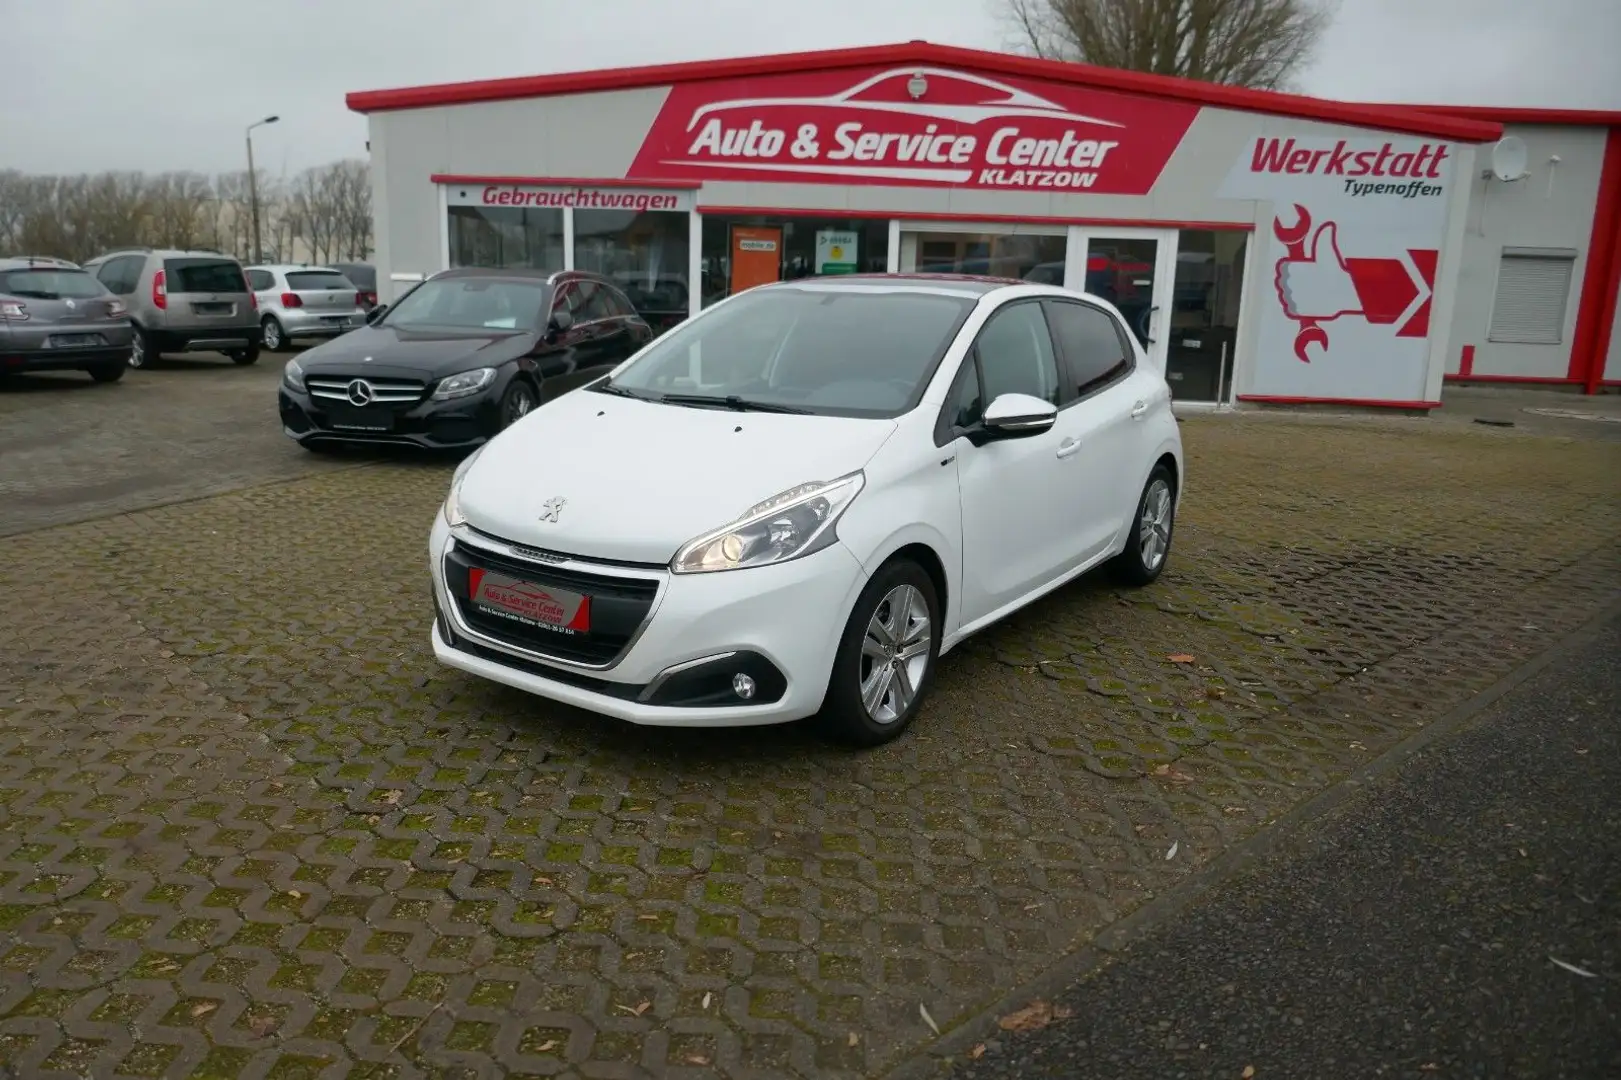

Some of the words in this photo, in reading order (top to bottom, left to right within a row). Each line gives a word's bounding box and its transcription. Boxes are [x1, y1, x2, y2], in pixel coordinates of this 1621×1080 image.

[688, 118, 785, 157] Auto
[790, 123, 820, 159] &
[827, 122, 976, 163] Service
[985, 127, 1119, 168] Center
[1251, 137, 1449, 178] Werkstatt
[978, 169, 1098, 187] KLATZOW
[1344, 179, 1443, 198] Typenoffen
[482, 185, 678, 213] Gebrauchtwagen
[484, 587, 500, 600] Auto
[509, 595, 537, 609] Service
[538, 600, 565, 616] Center
